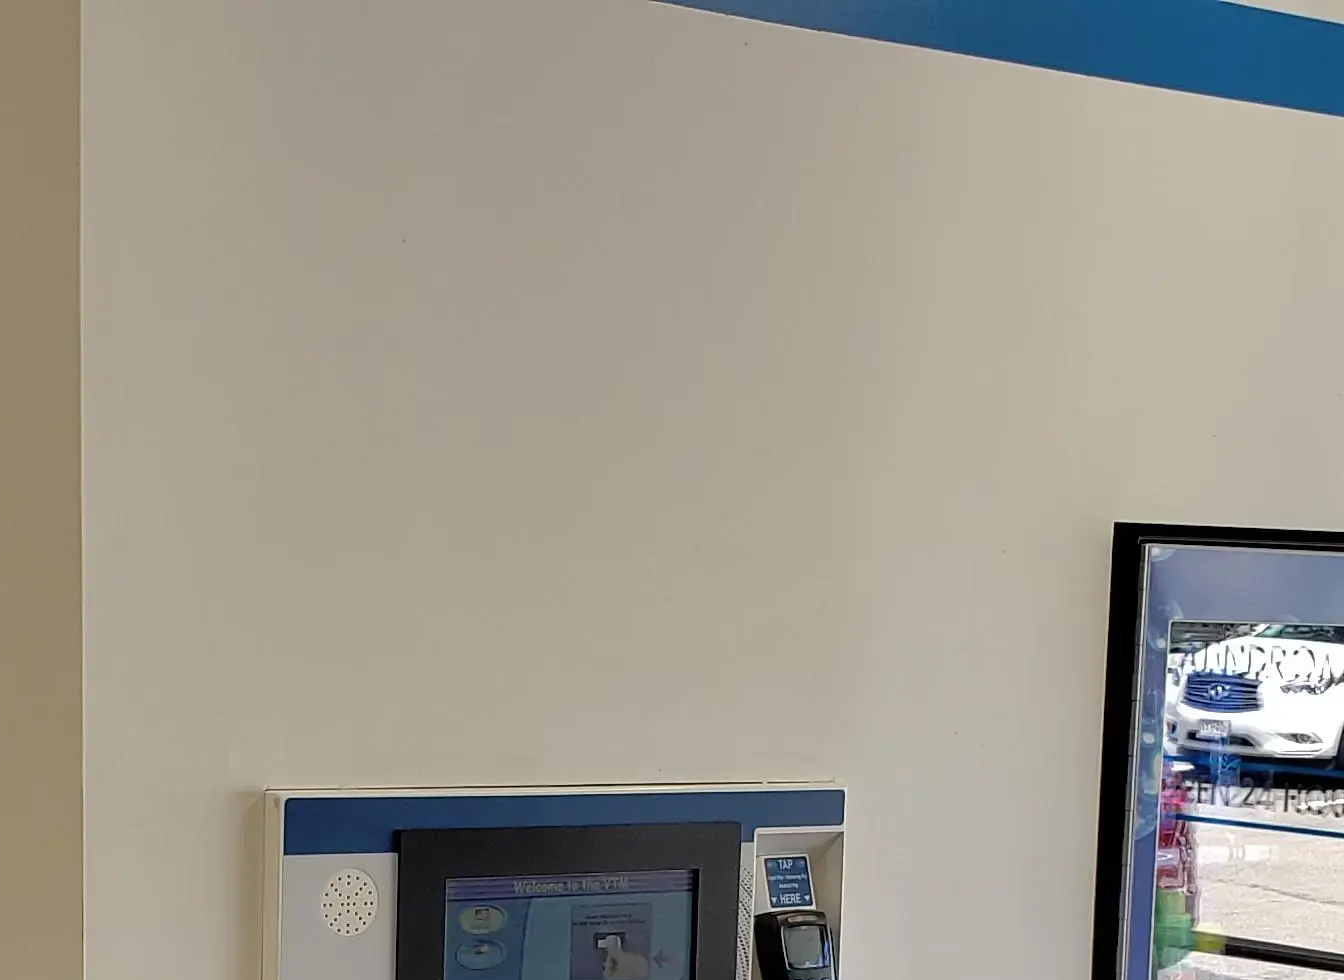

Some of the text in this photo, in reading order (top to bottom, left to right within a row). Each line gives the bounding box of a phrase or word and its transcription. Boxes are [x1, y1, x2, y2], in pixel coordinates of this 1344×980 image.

[1244, 775, 1275, 812] 24
[777, 859, 792, 869] TAP
[513, 881, 563, 894] Welcome
[780, 893, 801, 904] HERE
